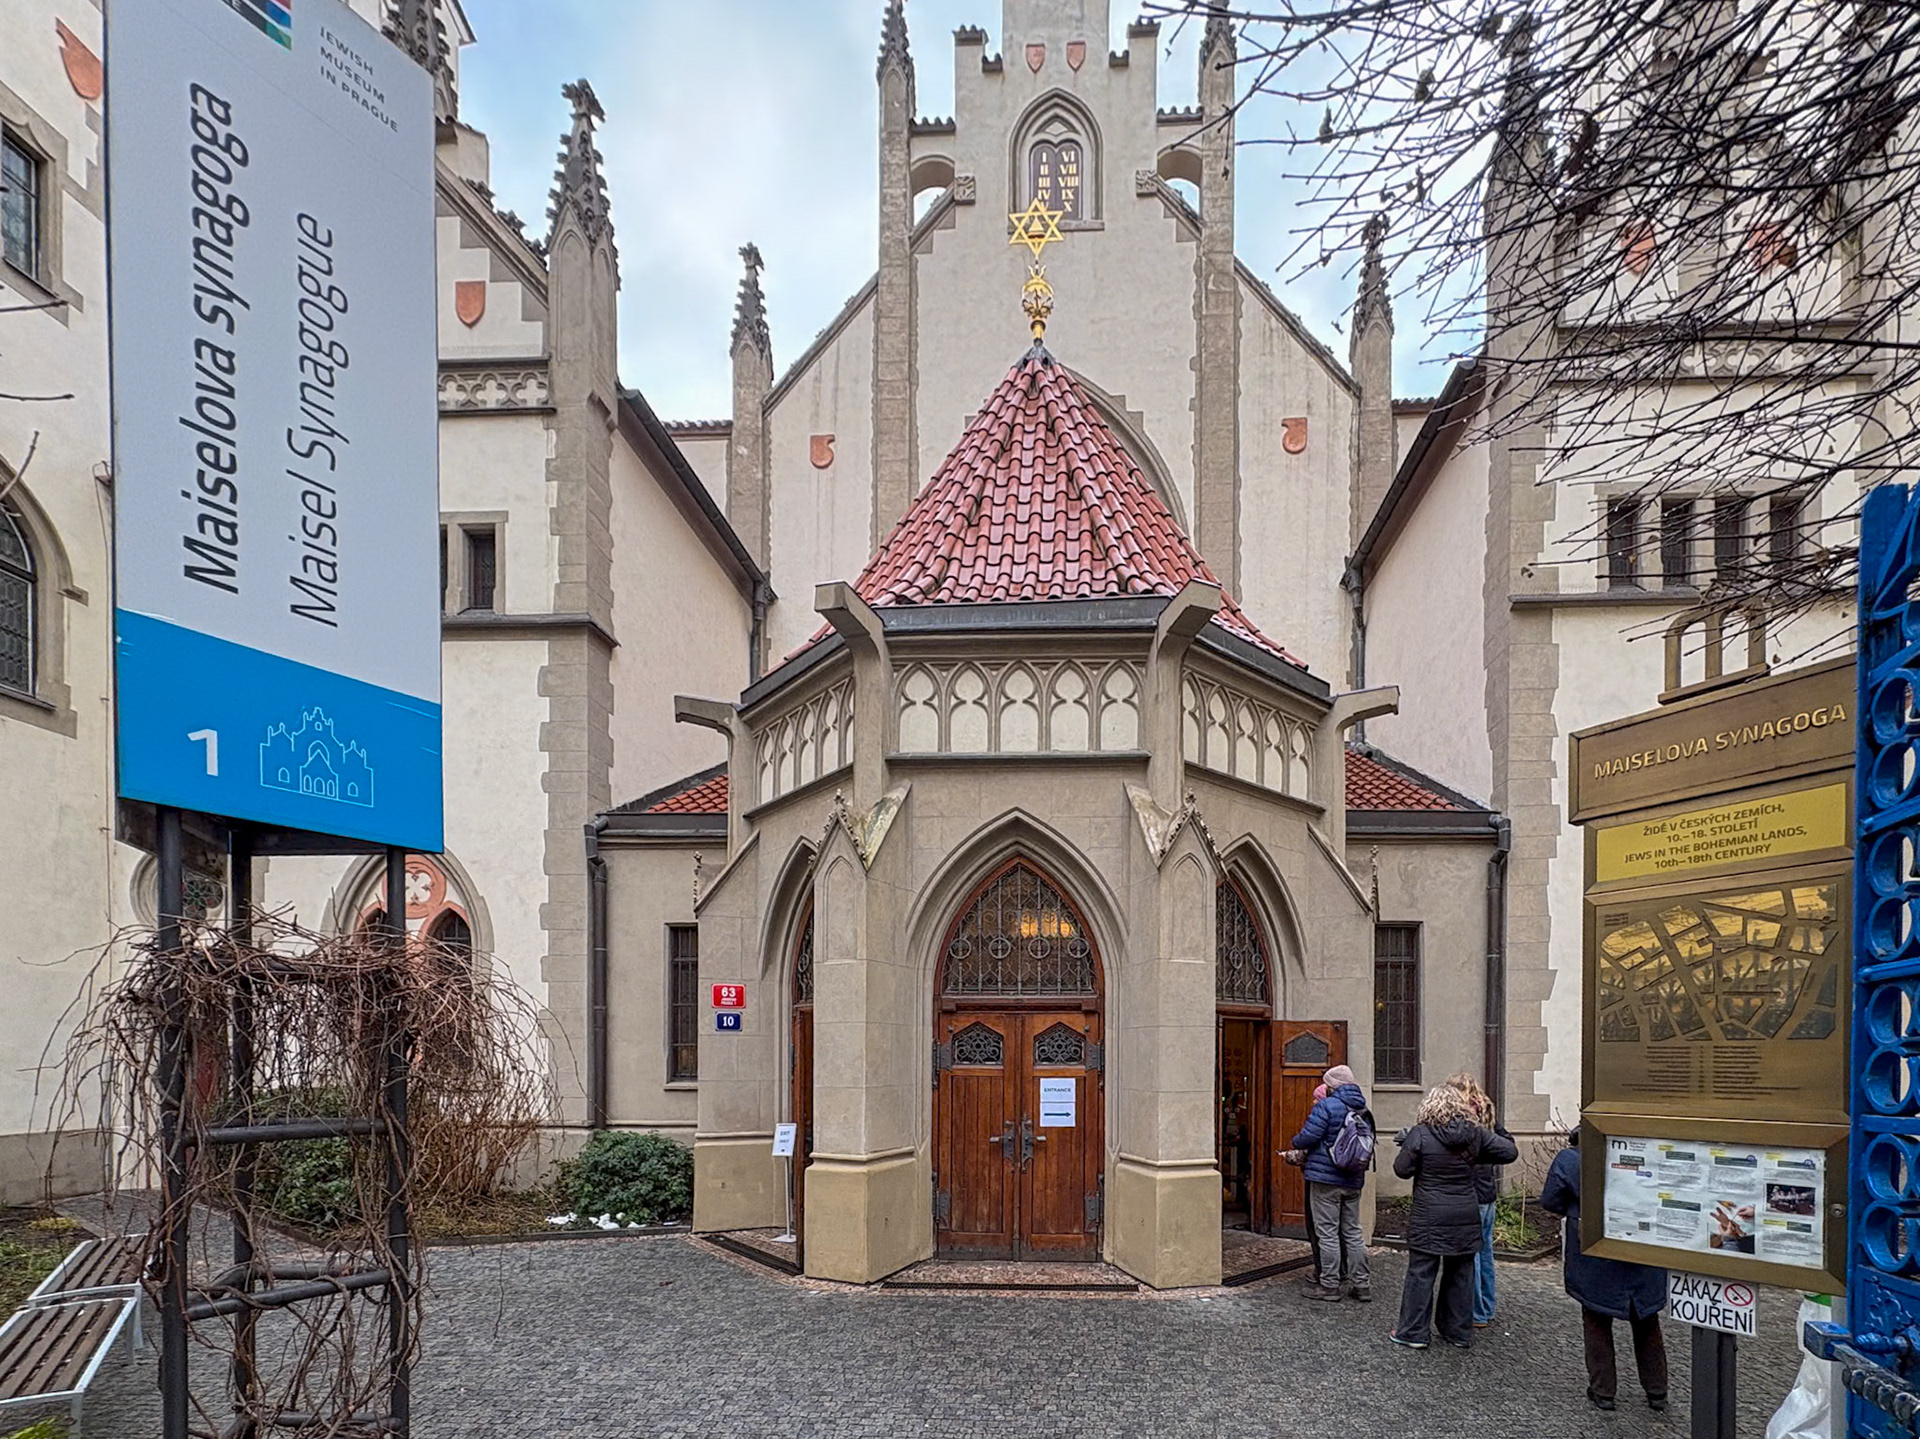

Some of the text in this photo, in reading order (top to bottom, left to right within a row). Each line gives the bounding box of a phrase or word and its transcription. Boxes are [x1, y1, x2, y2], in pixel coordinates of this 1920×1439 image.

[320, 26, 374, 76] JEWISH
[320, 46, 386, 104] MUSEUM
[320, 66, 399, 133] IN PRAGUE
[1042, 152, 1047, 163] I
[1061, 150, 1075, 163] VI
[1040, 164, 1049, 175] II
[1059, 163, 1077, 175] VII
[1038, 176, 1051, 188] III
[1057, 175, 1079, 188] VIII
[1037, 188, 1051, 200] IV
[1061, 188, 1075, 200] IX
[1063, 201, 1073, 212] X
[178, 82, 250, 595] Maiselova synagoga
[285, 212, 350, 628] Maisel Synagogue
[1593, 703, 1848, 780] MAISELOVA SYNAGOGA
[187, 728, 219, 777] 1
[1643, 803, 1786, 836] ŽIDÉ V ČESKÝCH ZEMÍCH,
[1710, 817, 1759, 836] STOLETÍ
[1624, 826, 1808, 864] JEWS IN THE BOHEMIAN LANDS,
[1714, 843, 1772, 861] CENTURY
[721, 986, 737, 998] 63
[722, 1015, 735, 1027] 10
[1670, 1272, 1723, 1304] ZÁKAZ
[1670, 1297, 1754, 1334] KOUŘENÍ
